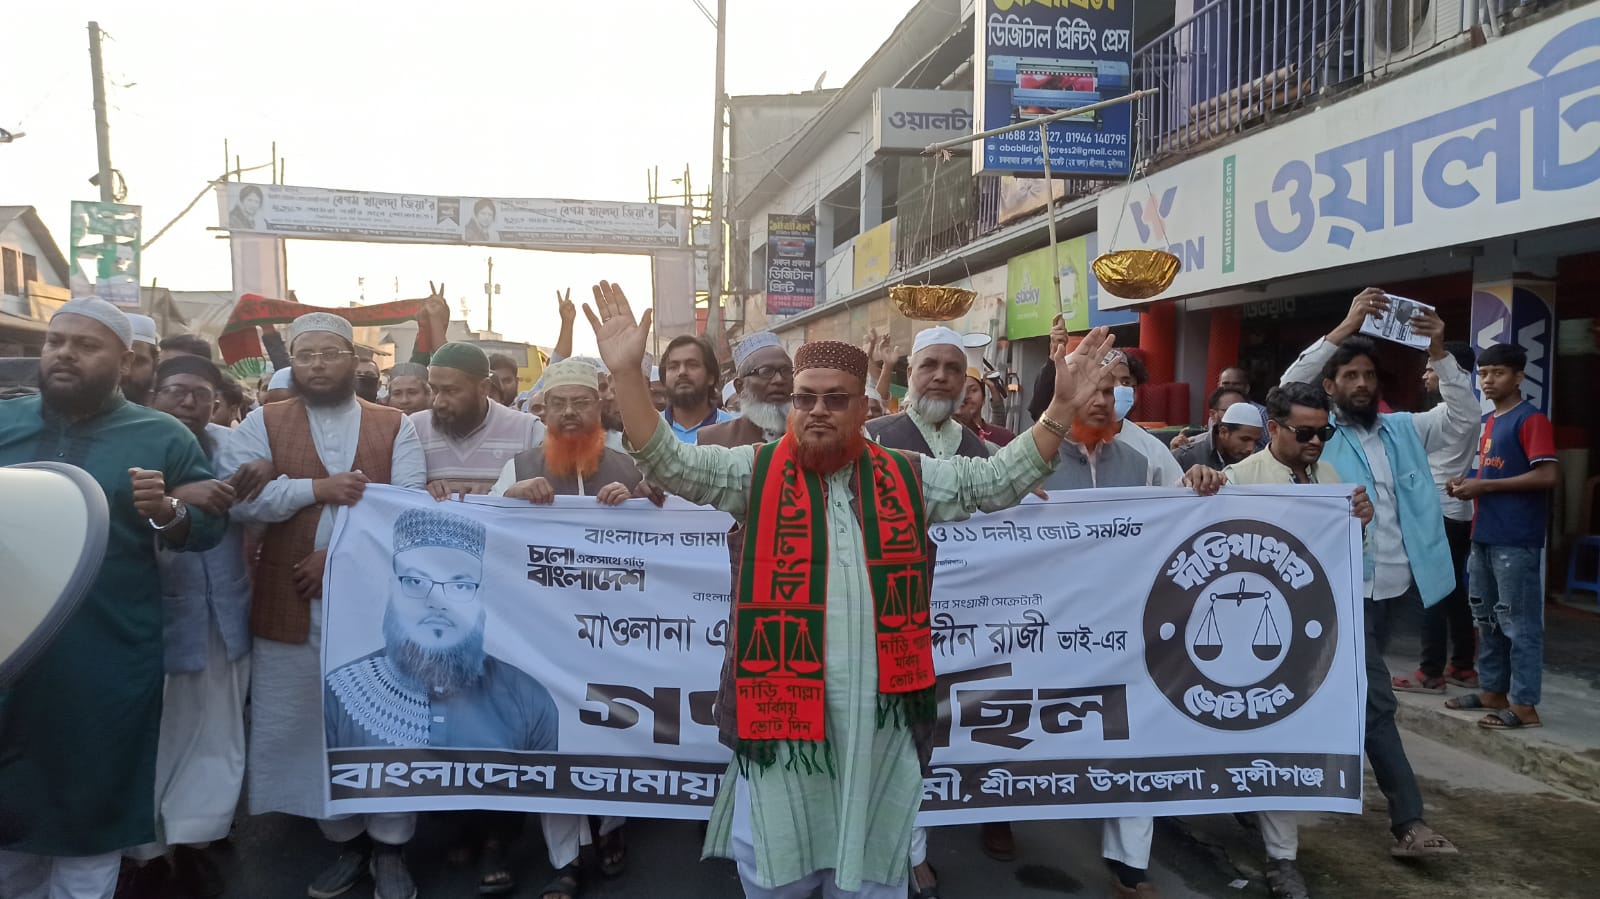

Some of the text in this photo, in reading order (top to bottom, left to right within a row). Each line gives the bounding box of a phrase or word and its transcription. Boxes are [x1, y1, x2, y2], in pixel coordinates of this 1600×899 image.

[987, 13, 1130, 55] ডিজিটাল প্রিন্টিং প্রেস
[1028, 130, 1062, 144] 23127,
[1065, 132, 1091, 143] 01946
[1094, 133, 1127, 145] 140795
[1224, 163, 1233, 265] waltonplc.com
[769, 266, 814, 280] ডিজিটাল
[585, 528, 675, 546] বাংলাদেশ
[679, 531, 728, 548] জামা
[953, 526, 977, 542] ১১
[982, 521, 1033, 543] দলীয়
[1037, 521, 1081, 541] জোট
[1085, 516, 1144, 539] সমর্থিত
[527, 544, 575, 566] চলো
[576, 553, 621, 566] একসাথে
[527, 563, 646, 592] বাংলাদেশ
[952, 595, 989, 609] সংগ্রামী
[991, 594, 1043, 607] সেক্রেটারী
[574, 611, 696, 652] মাওলানা
[985, 609, 1049, 656] রাজী
[1057, 624, 1128, 652] ভাই-এর
[750, 717, 811, 734] ভোট দিন
[331, 761, 556, 791] বাংলাদেশ
[980, 768, 1077, 798] শ্রীনগর
